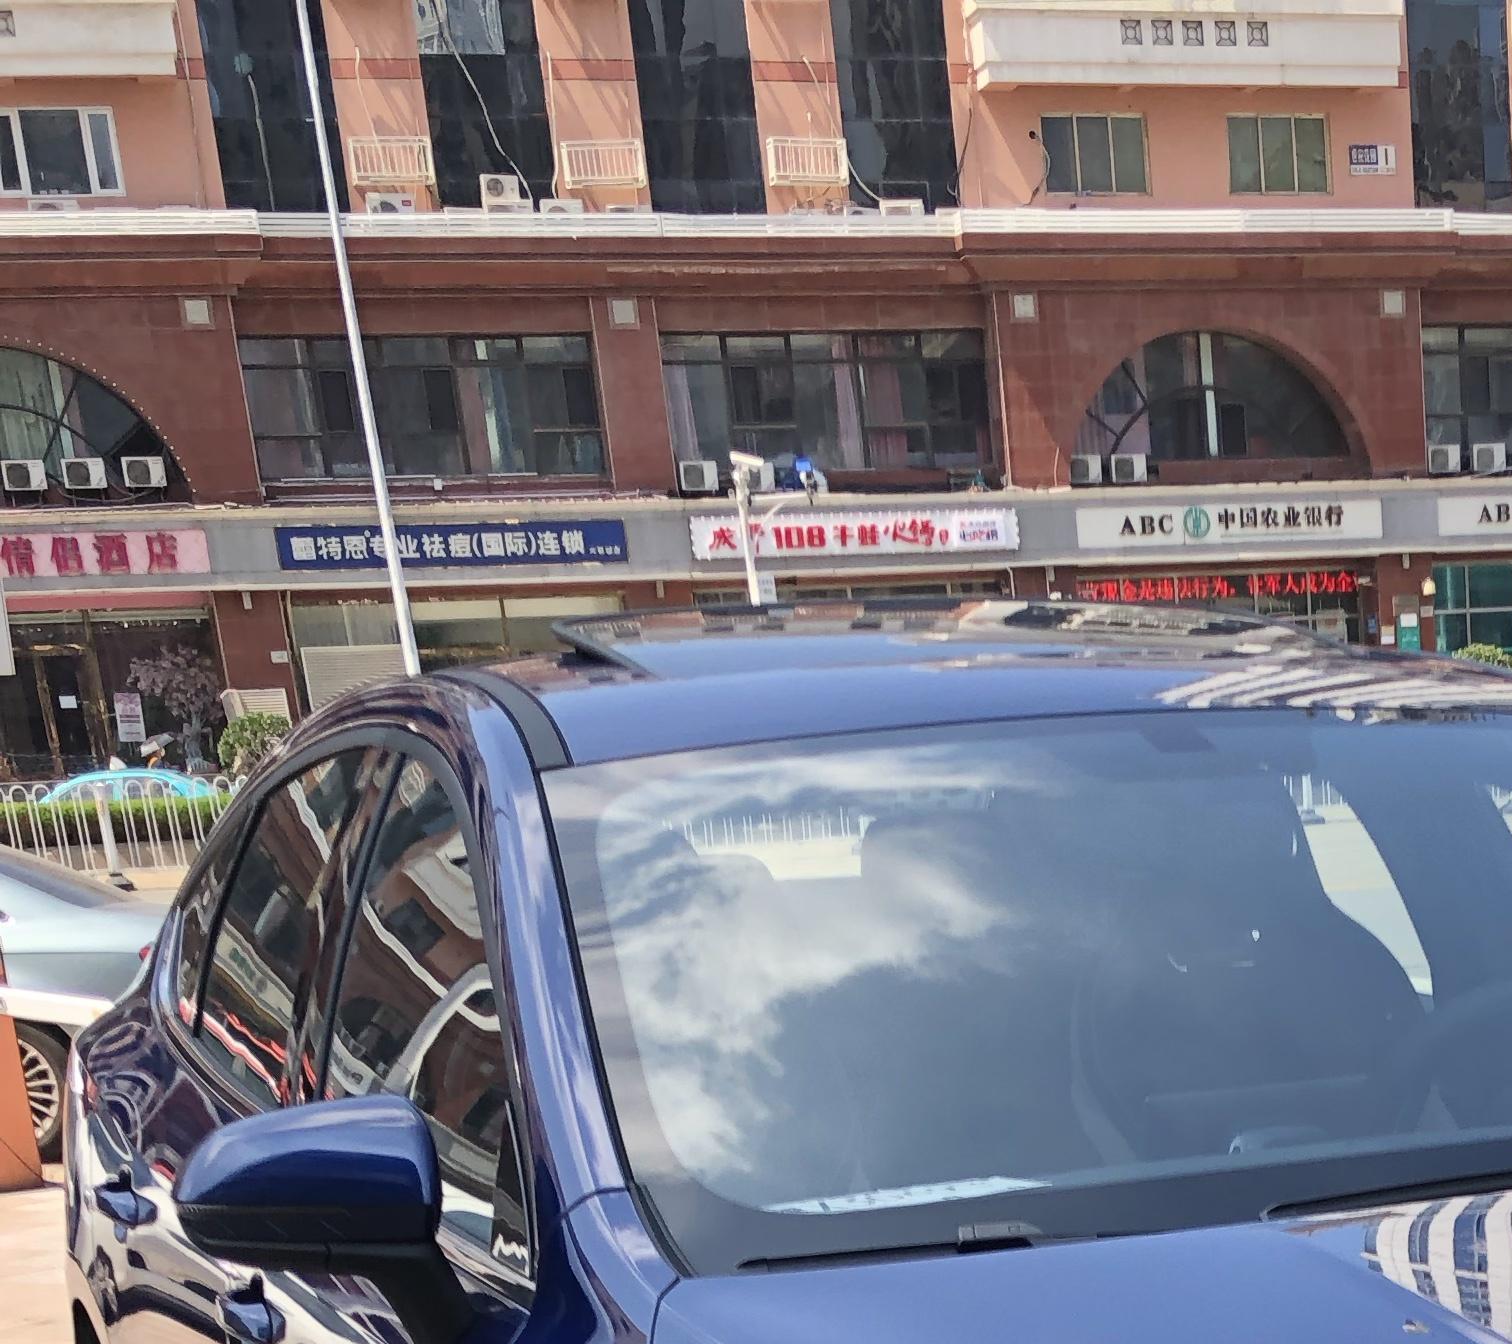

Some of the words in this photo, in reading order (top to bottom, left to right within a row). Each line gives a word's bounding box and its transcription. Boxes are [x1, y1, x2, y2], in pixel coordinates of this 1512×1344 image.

[1119, 513, 1174, 537] ABC
[1218, 503, 1344, 531] 中国农业银行
